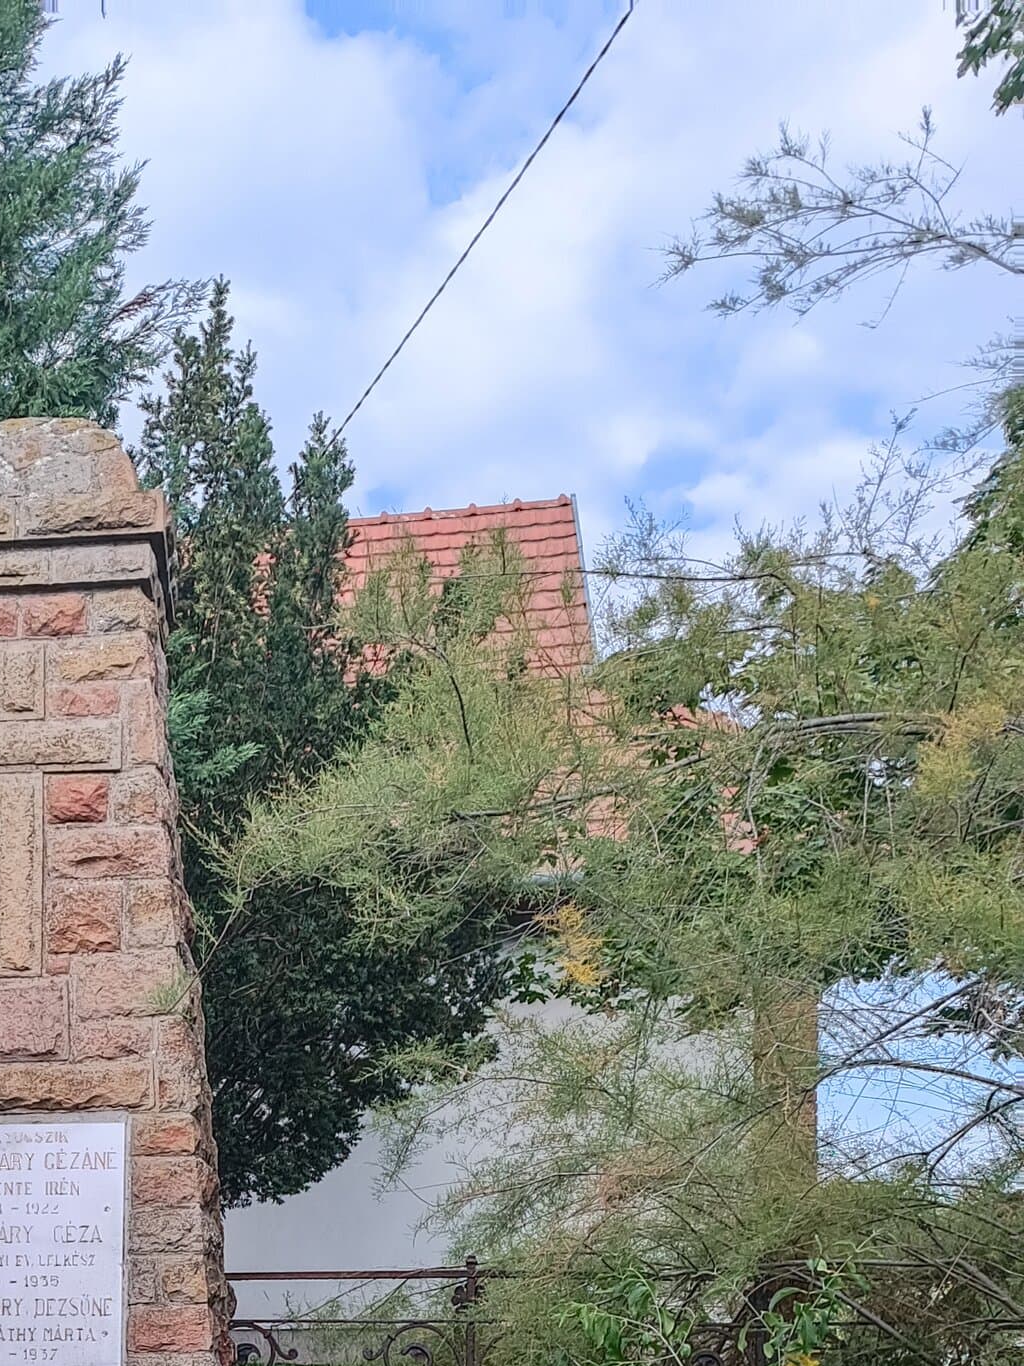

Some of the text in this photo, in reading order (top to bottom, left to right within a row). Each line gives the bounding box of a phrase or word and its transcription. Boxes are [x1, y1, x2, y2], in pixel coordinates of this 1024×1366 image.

[44, 1177, 81, 1196] IRÉN
[24, 1202, 60, 1216] 1922
[52, 1221, 103, 1244] GÉZA
[24, 1275, 60, 1288] 1935
[42, 1323, 96, 1342] MÁRTA
[22, 1348, 59, 1361] 1937
